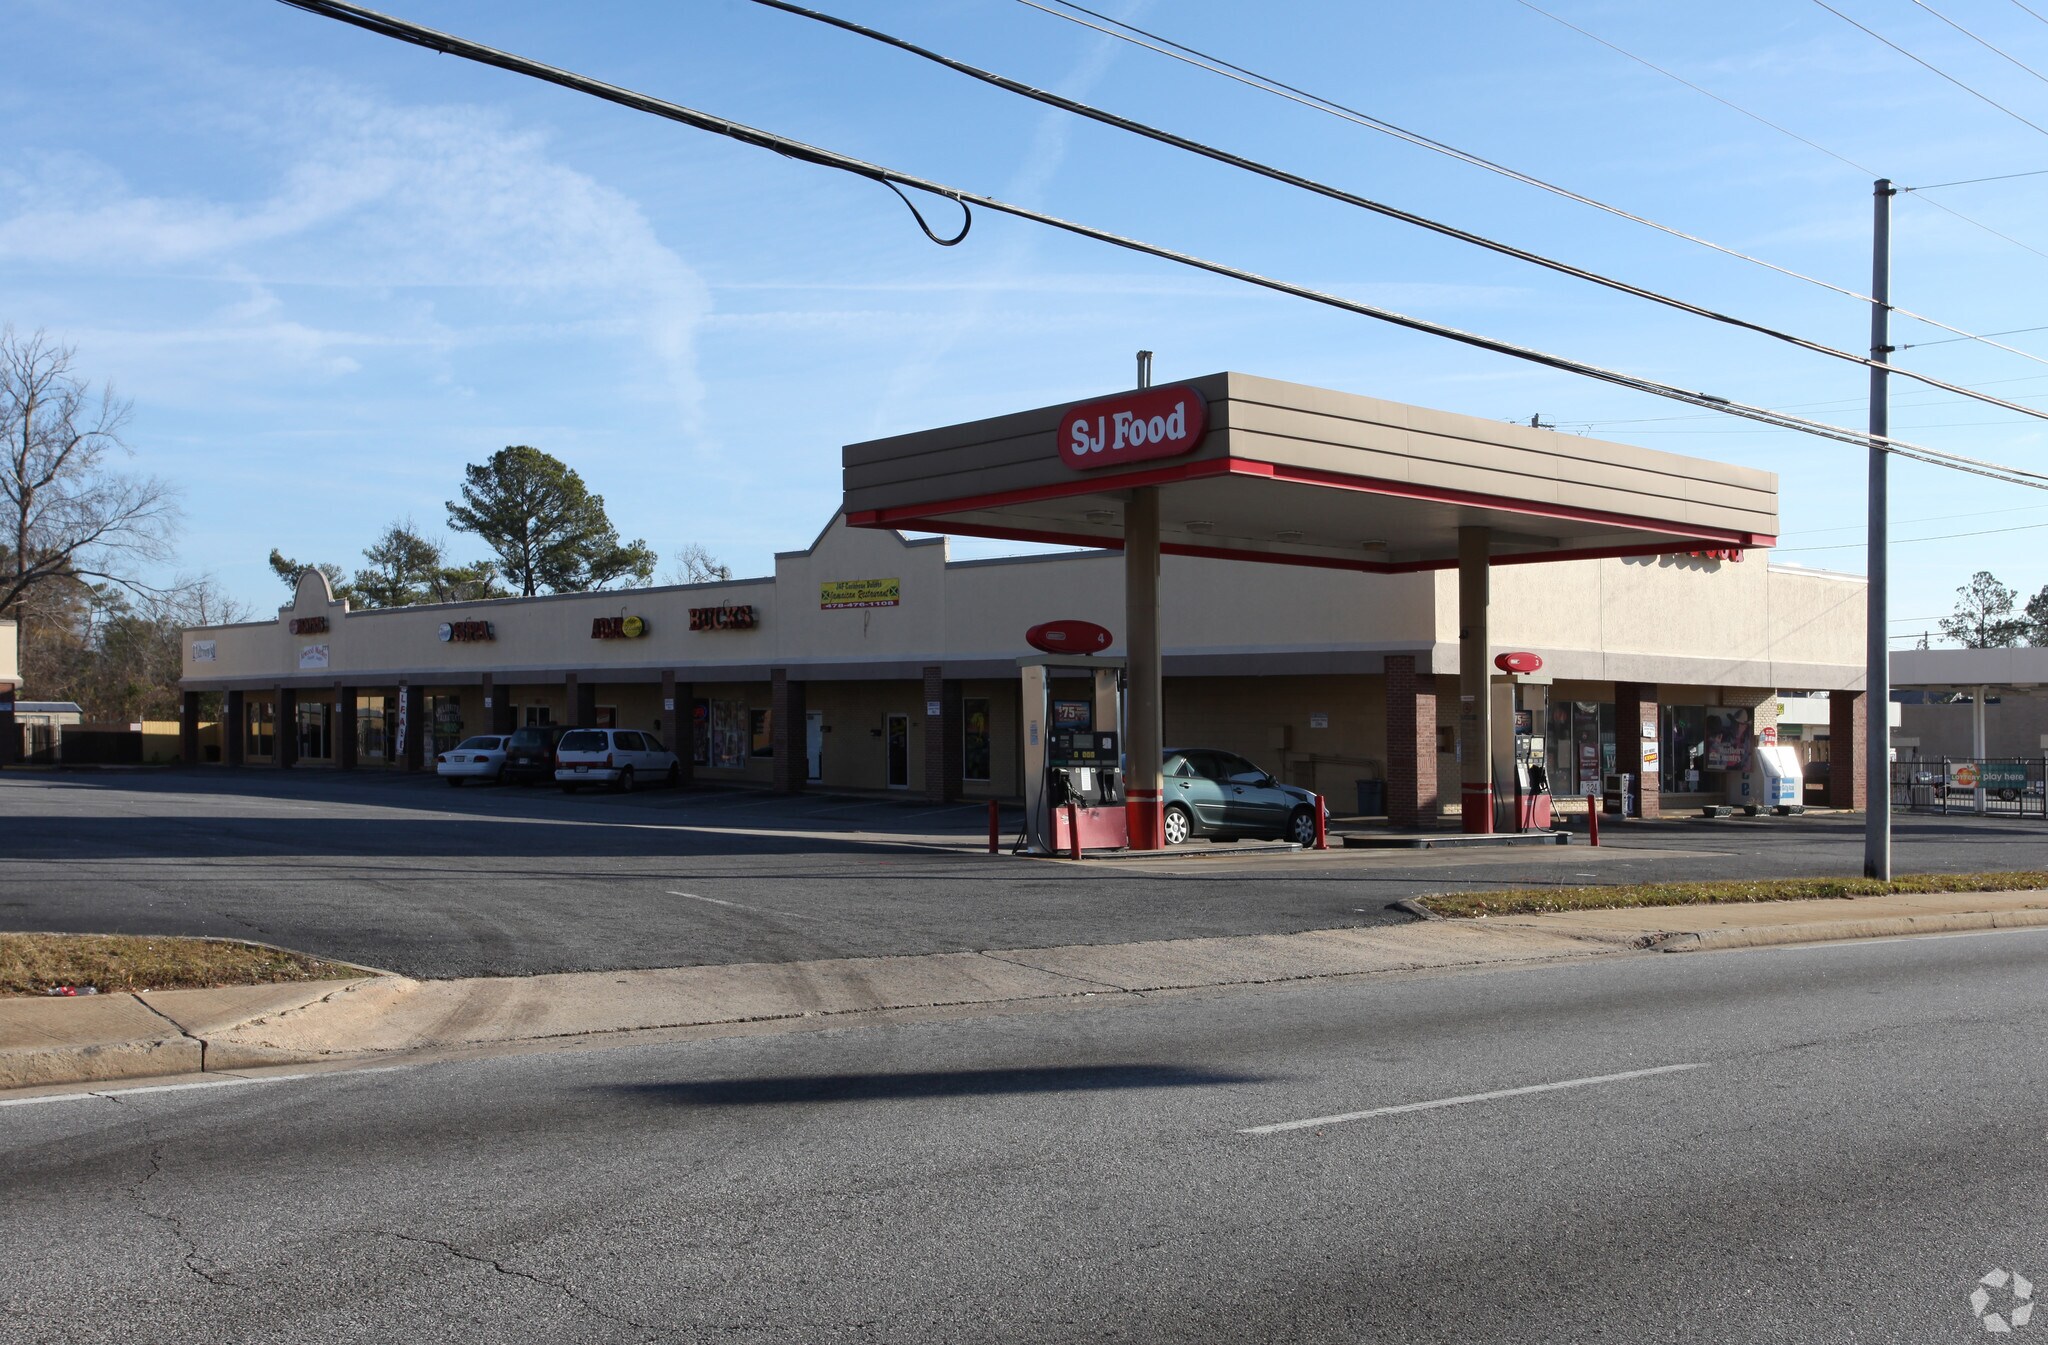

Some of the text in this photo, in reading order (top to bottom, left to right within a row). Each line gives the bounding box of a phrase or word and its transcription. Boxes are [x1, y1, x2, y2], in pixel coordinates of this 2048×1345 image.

[1071, 401, 1187, 456] SJ Food
[688, 605, 753, 631] BUCKS
[453, 620, 490, 641] SPA
[1098, 633, 1105, 644] 4
[1983, 773, 2002, 782] play
[2004, 773, 2025, 781] here
